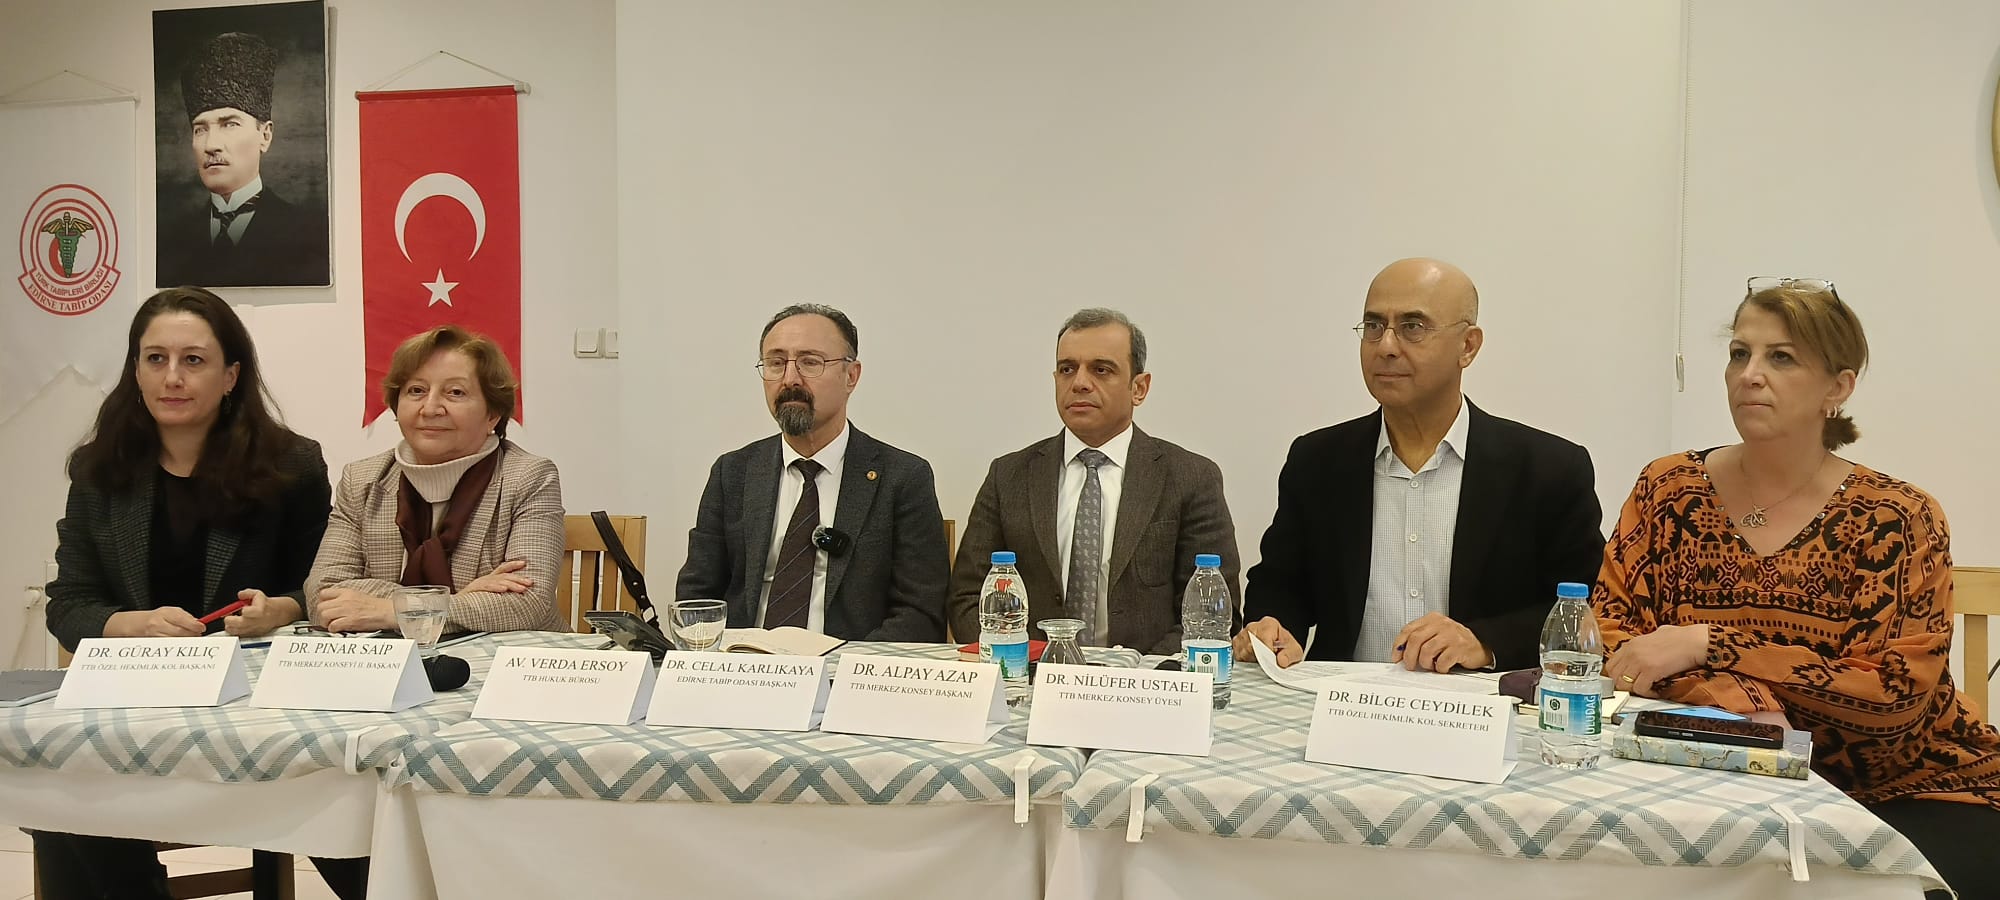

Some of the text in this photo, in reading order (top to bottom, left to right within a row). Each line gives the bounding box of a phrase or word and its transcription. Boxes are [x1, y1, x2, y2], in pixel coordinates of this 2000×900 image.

[59, 300, 88, 312] TABİP
[88, 280, 112, 304] ODASI
[87, 645, 220, 659] DR. GÜRAY KILIÇ
[288, 642, 393, 655] DR. PINAR SAİP
[97, 663, 118, 671] ÖZEL
[119, 663, 160, 671] HEKİMLİK
[179, 663, 216, 672] BAŞKANI
[278, 660, 293, 668] TTB
[366, 662, 401, 671] BAŞKANI
[505, 657, 629, 672] AV. VERDA ERSOY
[666, 659, 815, 677] DR. CELAL KARLIKAYA
[522, 674, 538, 682] TTB
[538, 675, 567, 683] HUKUK
[852, 662, 979, 684] DR. ALPAY AZAP
[676, 675, 797, 689] EDİRNE TABİP ODASI BAŞKANI
[1046, 673, 1199, 694] DR. NİLÜFER USTAEL
[850, 682, 974, 699] TTB MERKEZ KONSEY BAŞKANI
[1059, 691, 1183, 707] TTB MERKEZ KONSEY ÜYESİ
[1328, 690, 1494, 718] DR. BİLGE CEYDİLEK
[1328, 708, 1490, 732] TTB ÖZEL HEKİMLİK KOL SEKRETERİ
